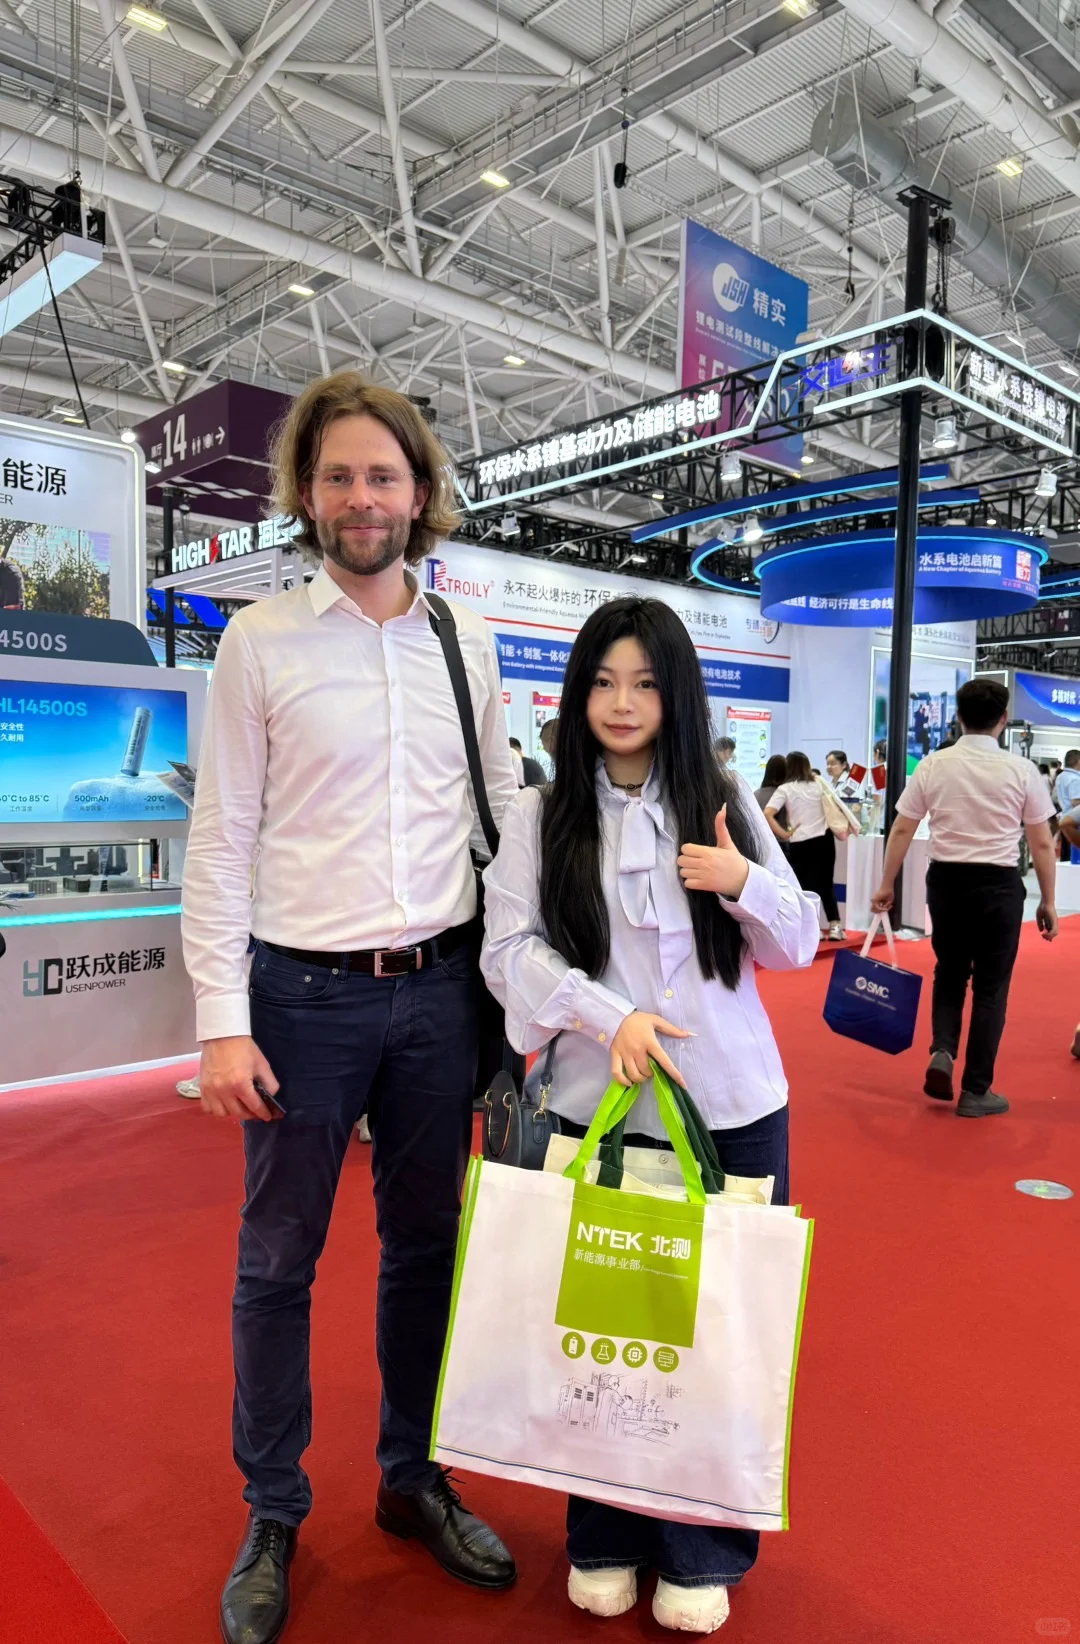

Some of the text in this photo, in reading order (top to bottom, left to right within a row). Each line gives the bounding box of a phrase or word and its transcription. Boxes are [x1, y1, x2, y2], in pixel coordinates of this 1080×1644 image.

[753, 287, 786, 326] 精实
[163, 413, 187, 467] 14
[3, 458, 67, 496] 能源
[920, 552, 1002, 569] 水系电池启新篇
[503, 579, 581, 606] 永不起火爆炸的
[74, 794, 109, 802] 500mAh
[66, 947, 166, 980] 跃成能源
[65, 978, 126, 993] USENPOWER
[866, 981, 889, 998] SMC
[576, 1221, 692, 1260] NTEK 北测
